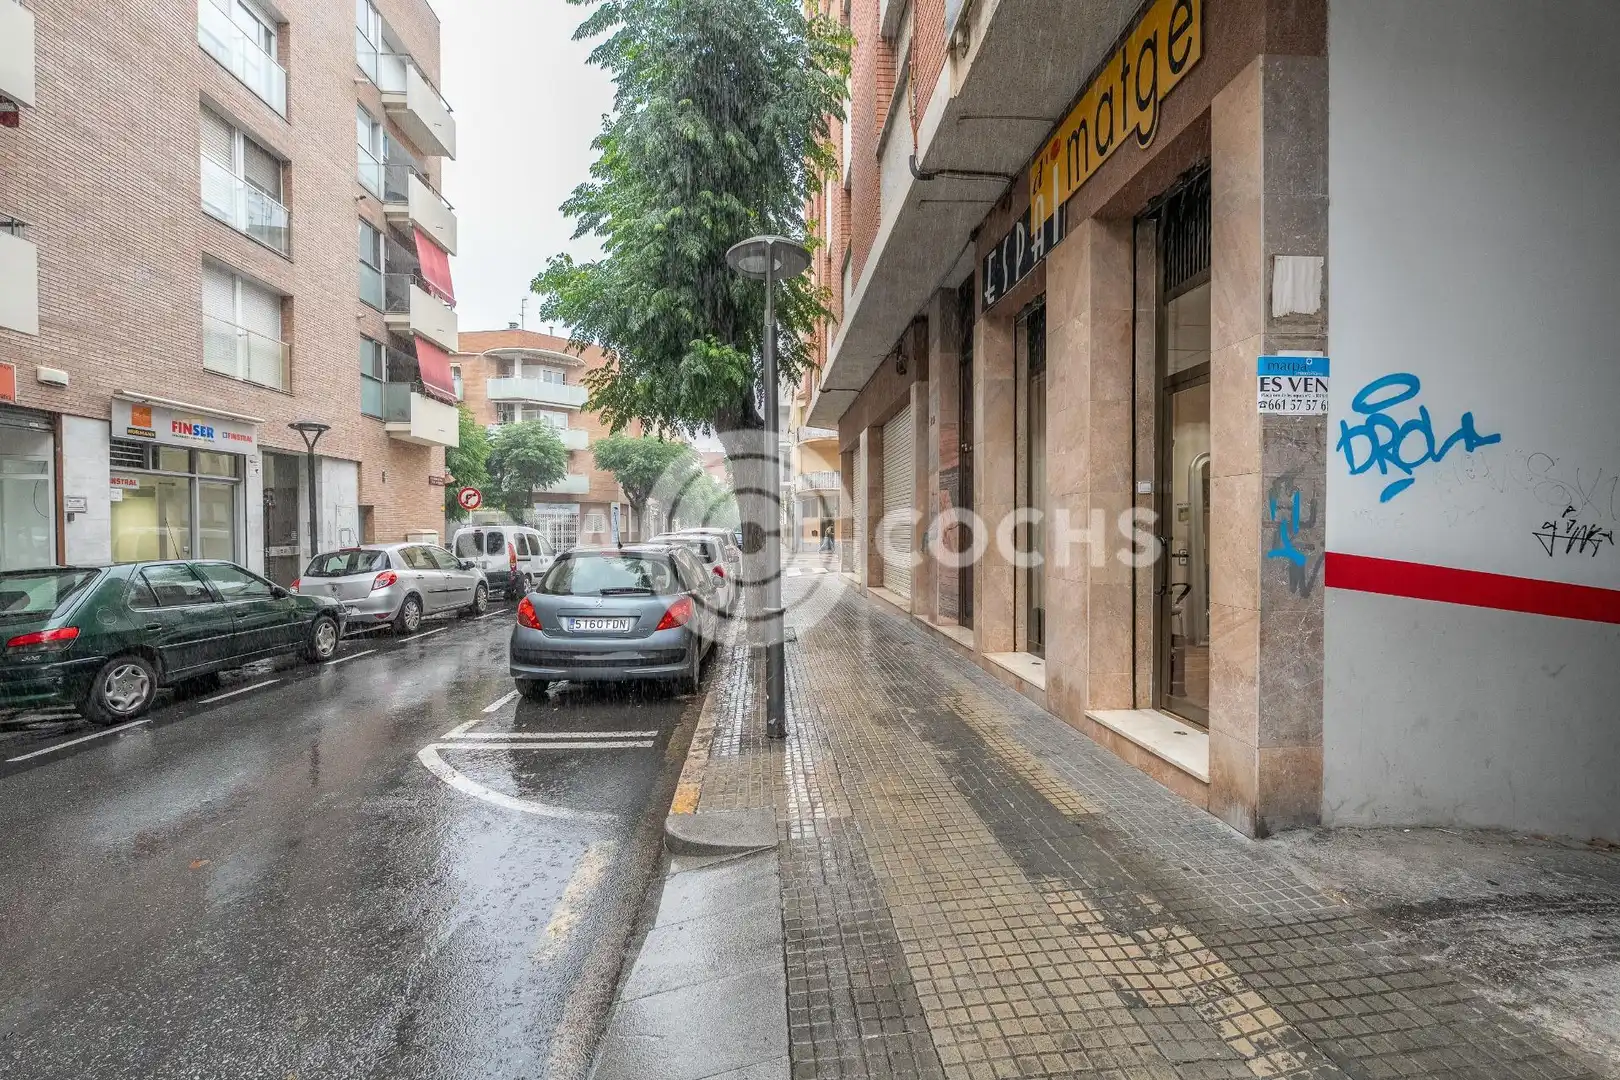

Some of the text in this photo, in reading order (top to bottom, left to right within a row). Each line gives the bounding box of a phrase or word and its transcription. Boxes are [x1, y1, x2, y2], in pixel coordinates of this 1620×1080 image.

[984, 163, 1061, 305] ESPAI
[1267, 362, 1307, 376] marpa
[1260, 376, 1283, 393] ES
[1268, 398, 1329, 412] 661 57 57 6
[171, 420, 215, 439] FINSER
[227, 432, 252, 443] FINSTRAL
[575, 619, 603, 630] 5160
[605, 619, 627, 630] FDN
